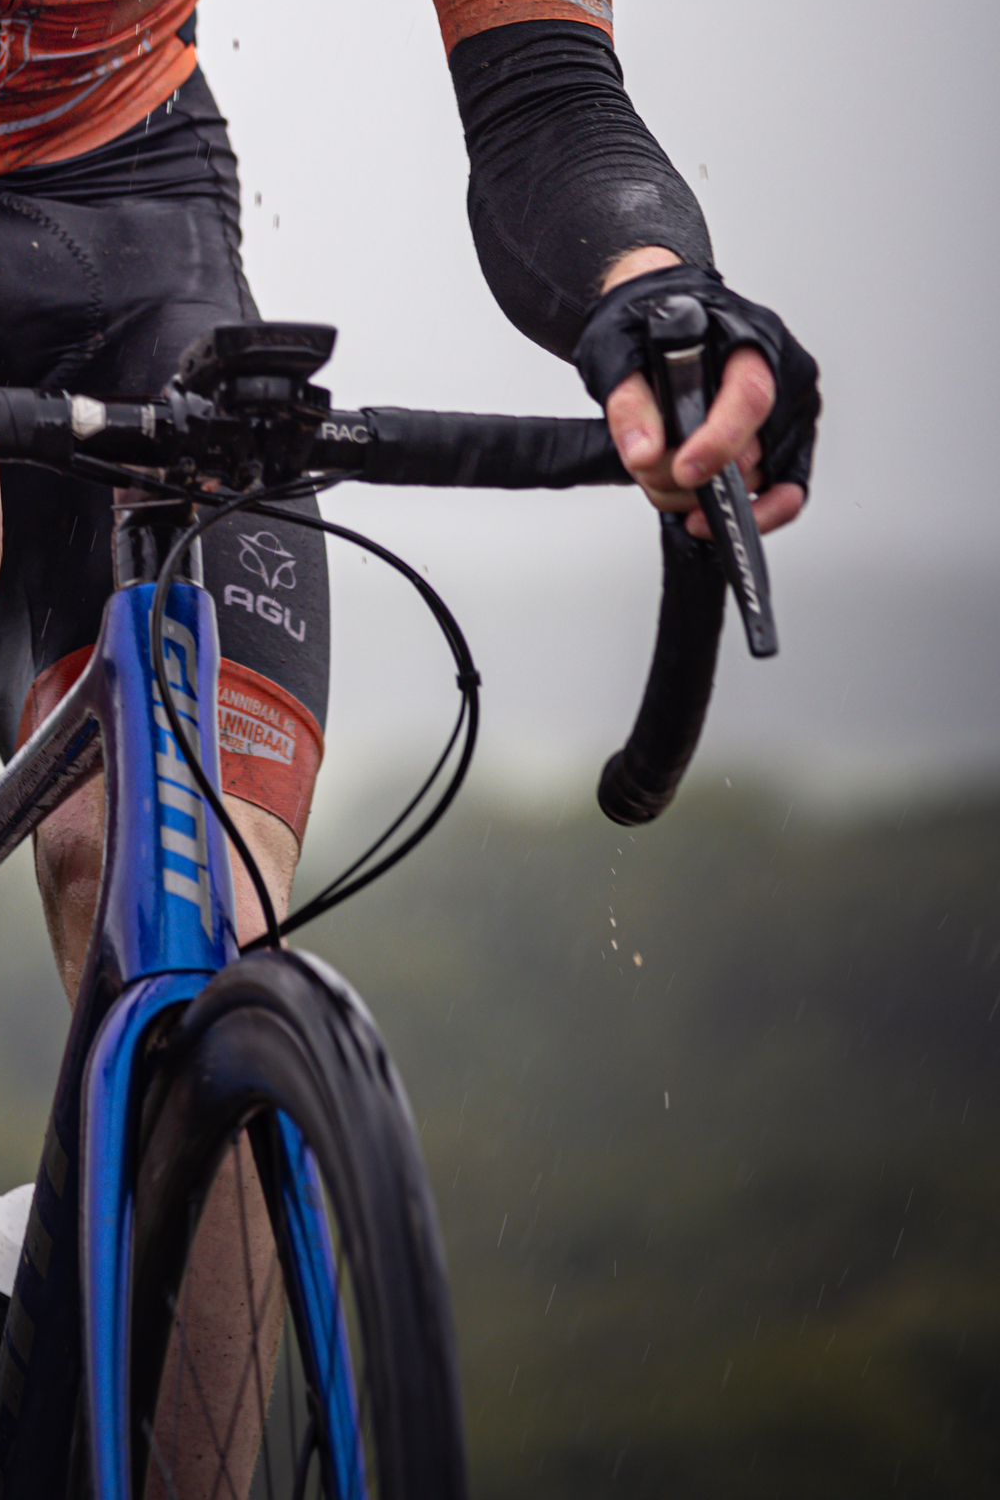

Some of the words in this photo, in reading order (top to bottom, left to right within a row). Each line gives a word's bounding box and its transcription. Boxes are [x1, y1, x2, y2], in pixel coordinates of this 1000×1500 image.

[321, 421, 370, 445] RAC
[223, 584, 307, 643] AGU
[148, 608, 215, 946] GIANT
